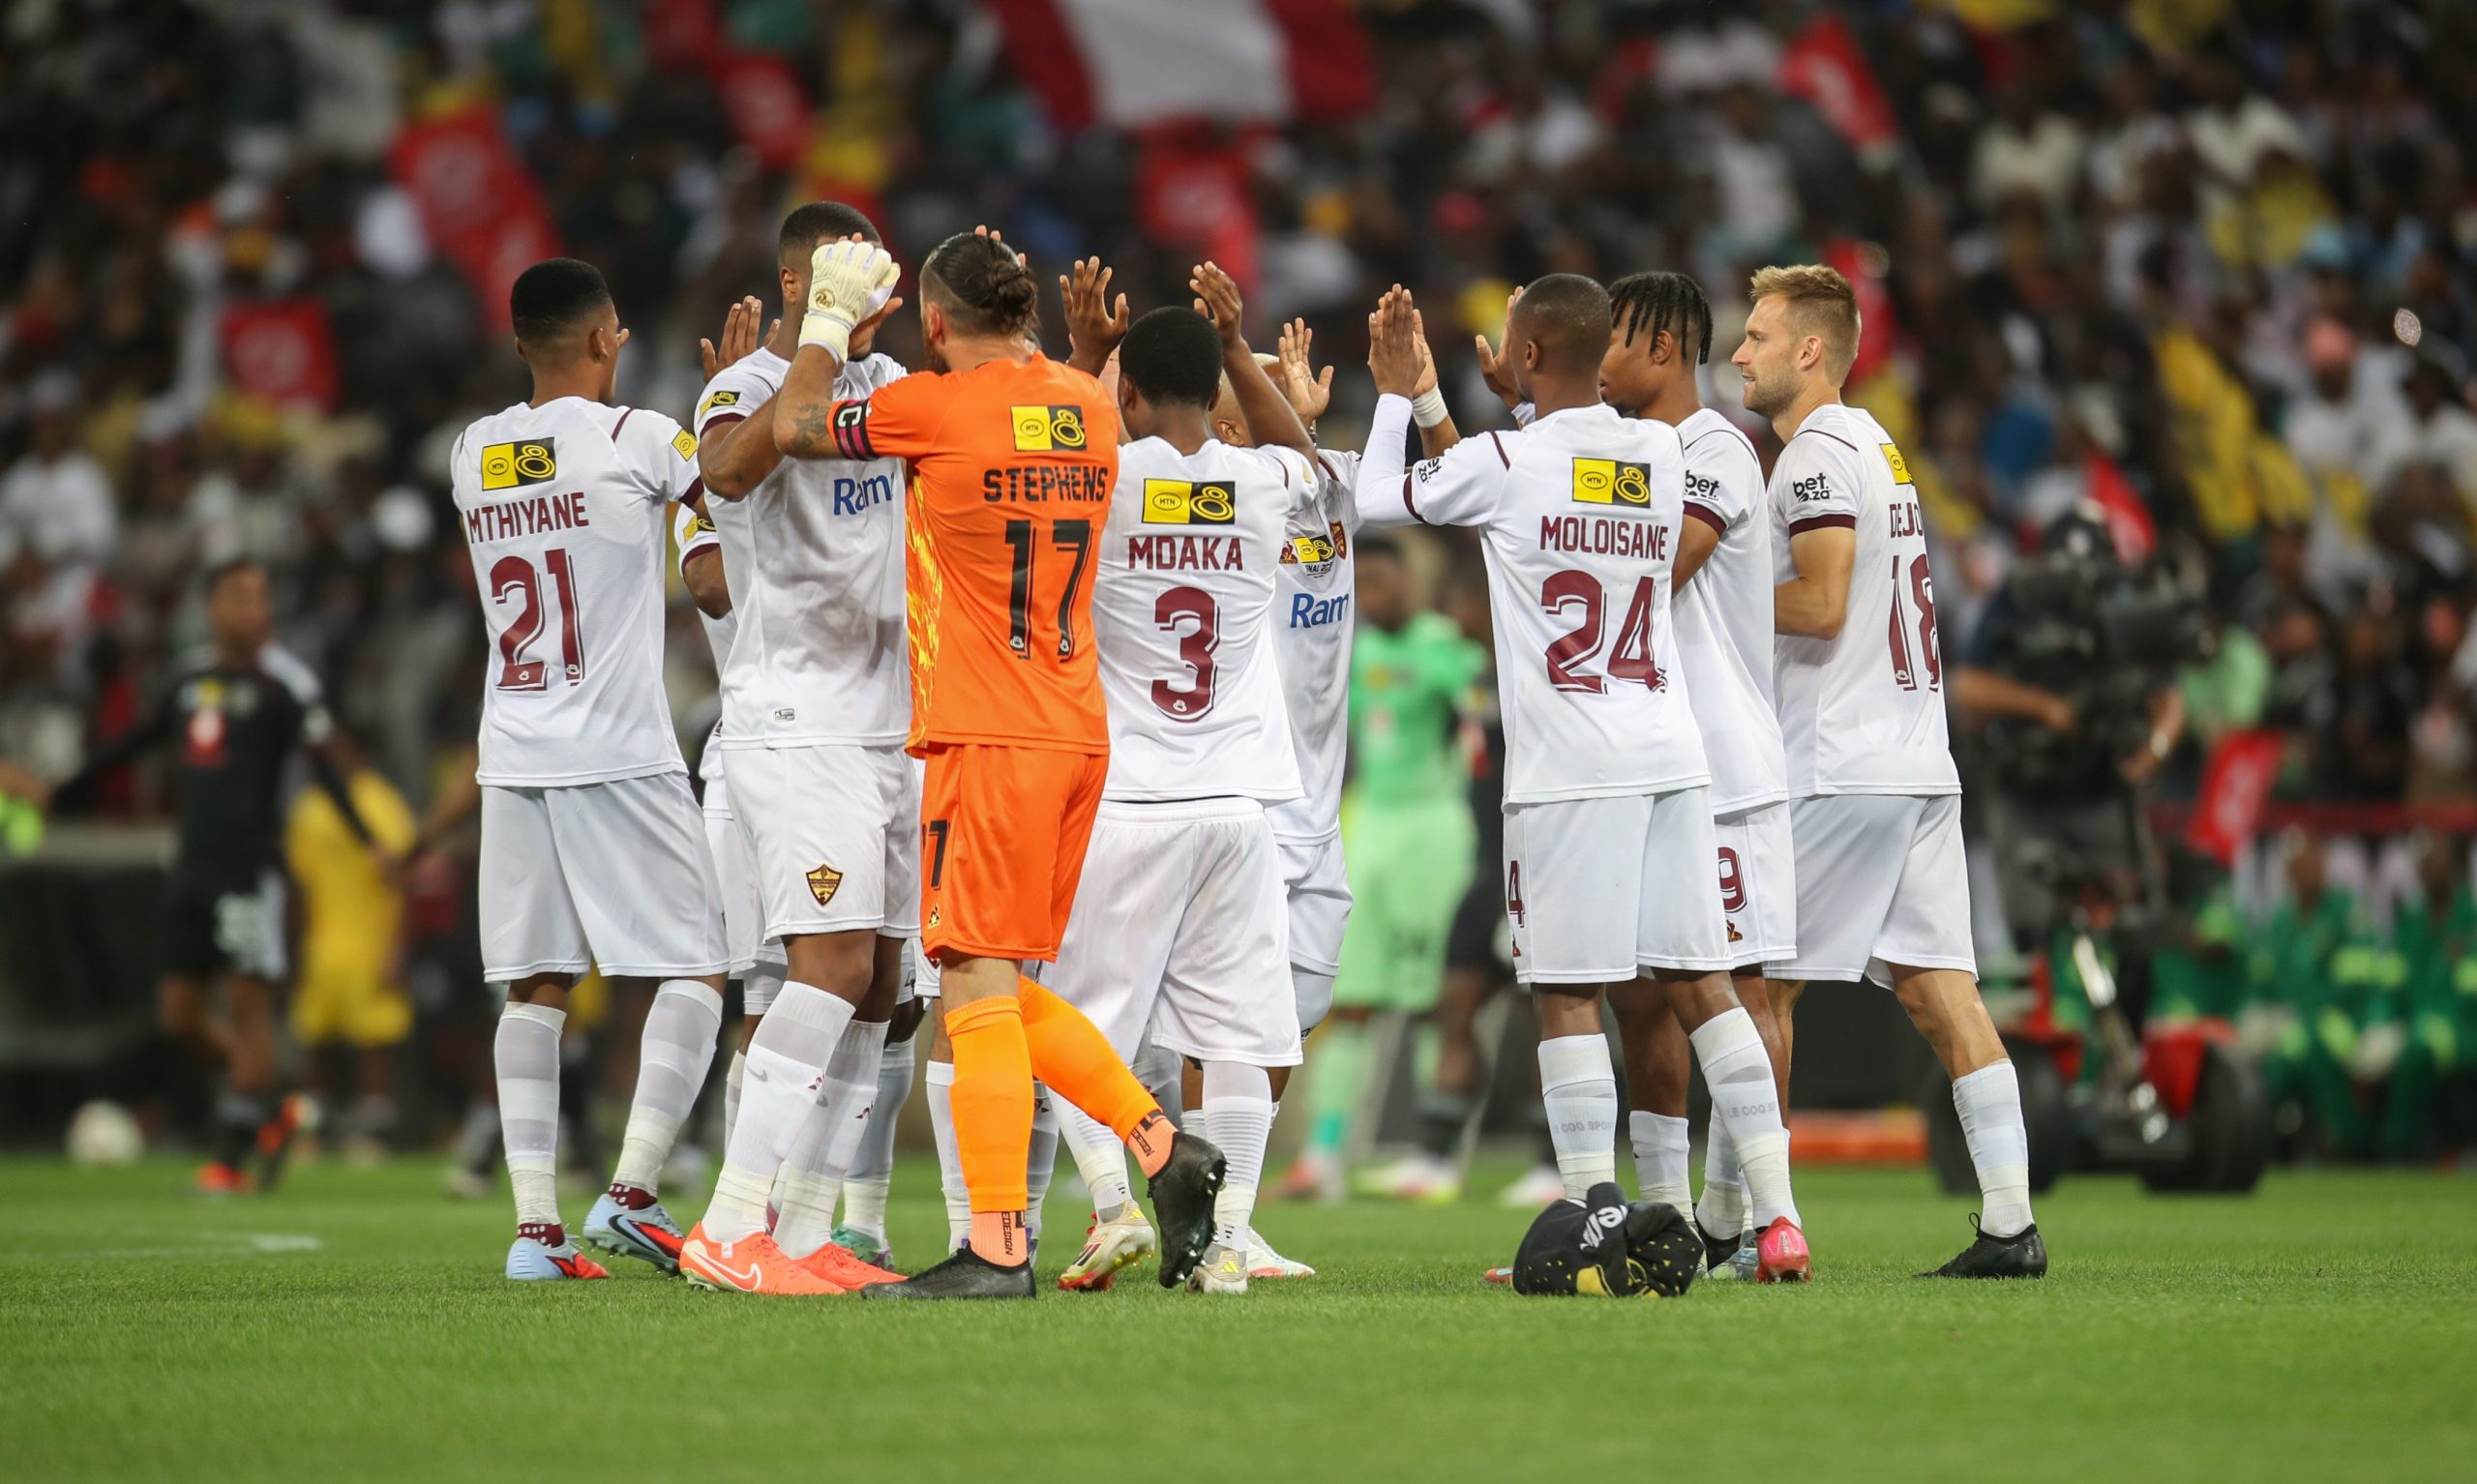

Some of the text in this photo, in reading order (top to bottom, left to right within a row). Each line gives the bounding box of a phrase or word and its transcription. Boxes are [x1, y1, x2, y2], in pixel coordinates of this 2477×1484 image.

[1051, 409, 1085, 447] 8
[515, 445, 555, 478] 8
[983, 465, 1109, 503] STEPHENS
[1615, 466, 1650, 503] 8
[466, 491, 589, 544] MTHIYANE
[1190, 486, 1235, 520] 8
[1128, 536, 1243, 571] MDAKA
[1540, 516, 1668, 561] MOLOISANE
[1004, 519, 1093, 664] 17
[490, 549, 585, 691] 21
[1540, 570, 1668, 696] 24
[1889, 553, 1941, 694] 18
[1151, 586, 1221, 724] 3
[922, 819, 950, 891] 7
[1507, 860, 1526, 928] 4
